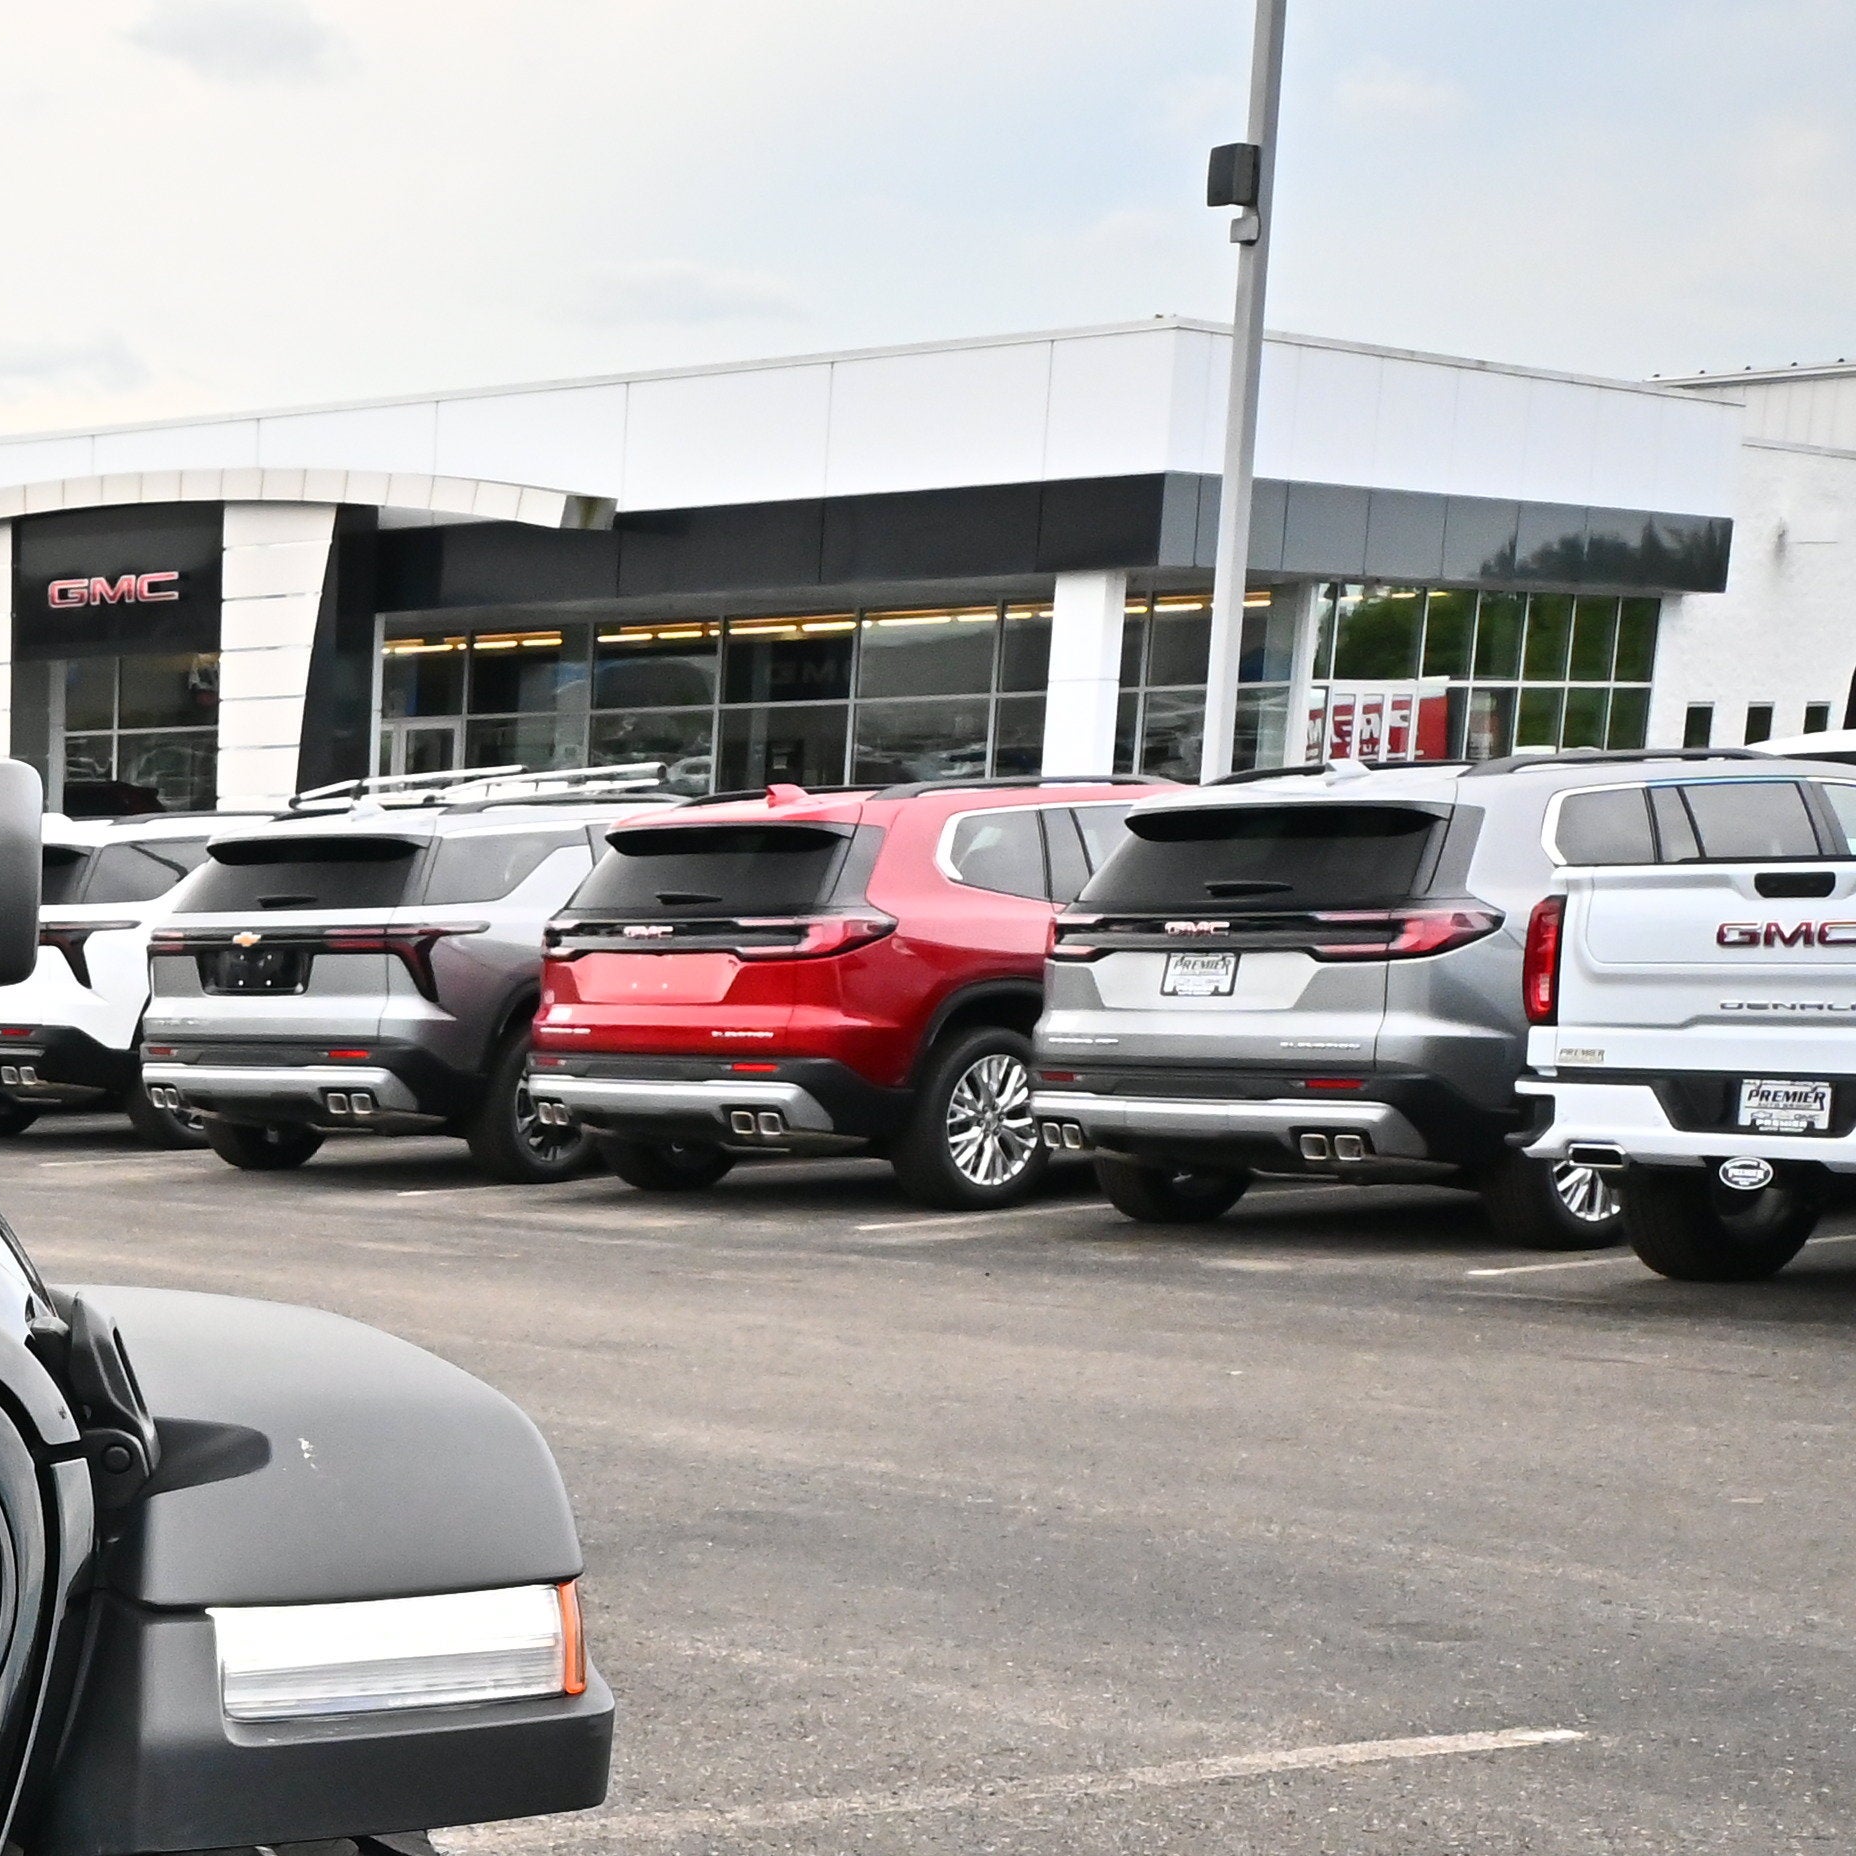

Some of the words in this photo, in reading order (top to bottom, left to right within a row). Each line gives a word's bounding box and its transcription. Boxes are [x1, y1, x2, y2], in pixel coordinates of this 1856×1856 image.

[48, 571, 180, 608] GMC
[1164, 921, 1230, 936] GMC
[1716, 921, 1856, 948] GMC
[1747, 1088, 1826, 1108] PREMIER
